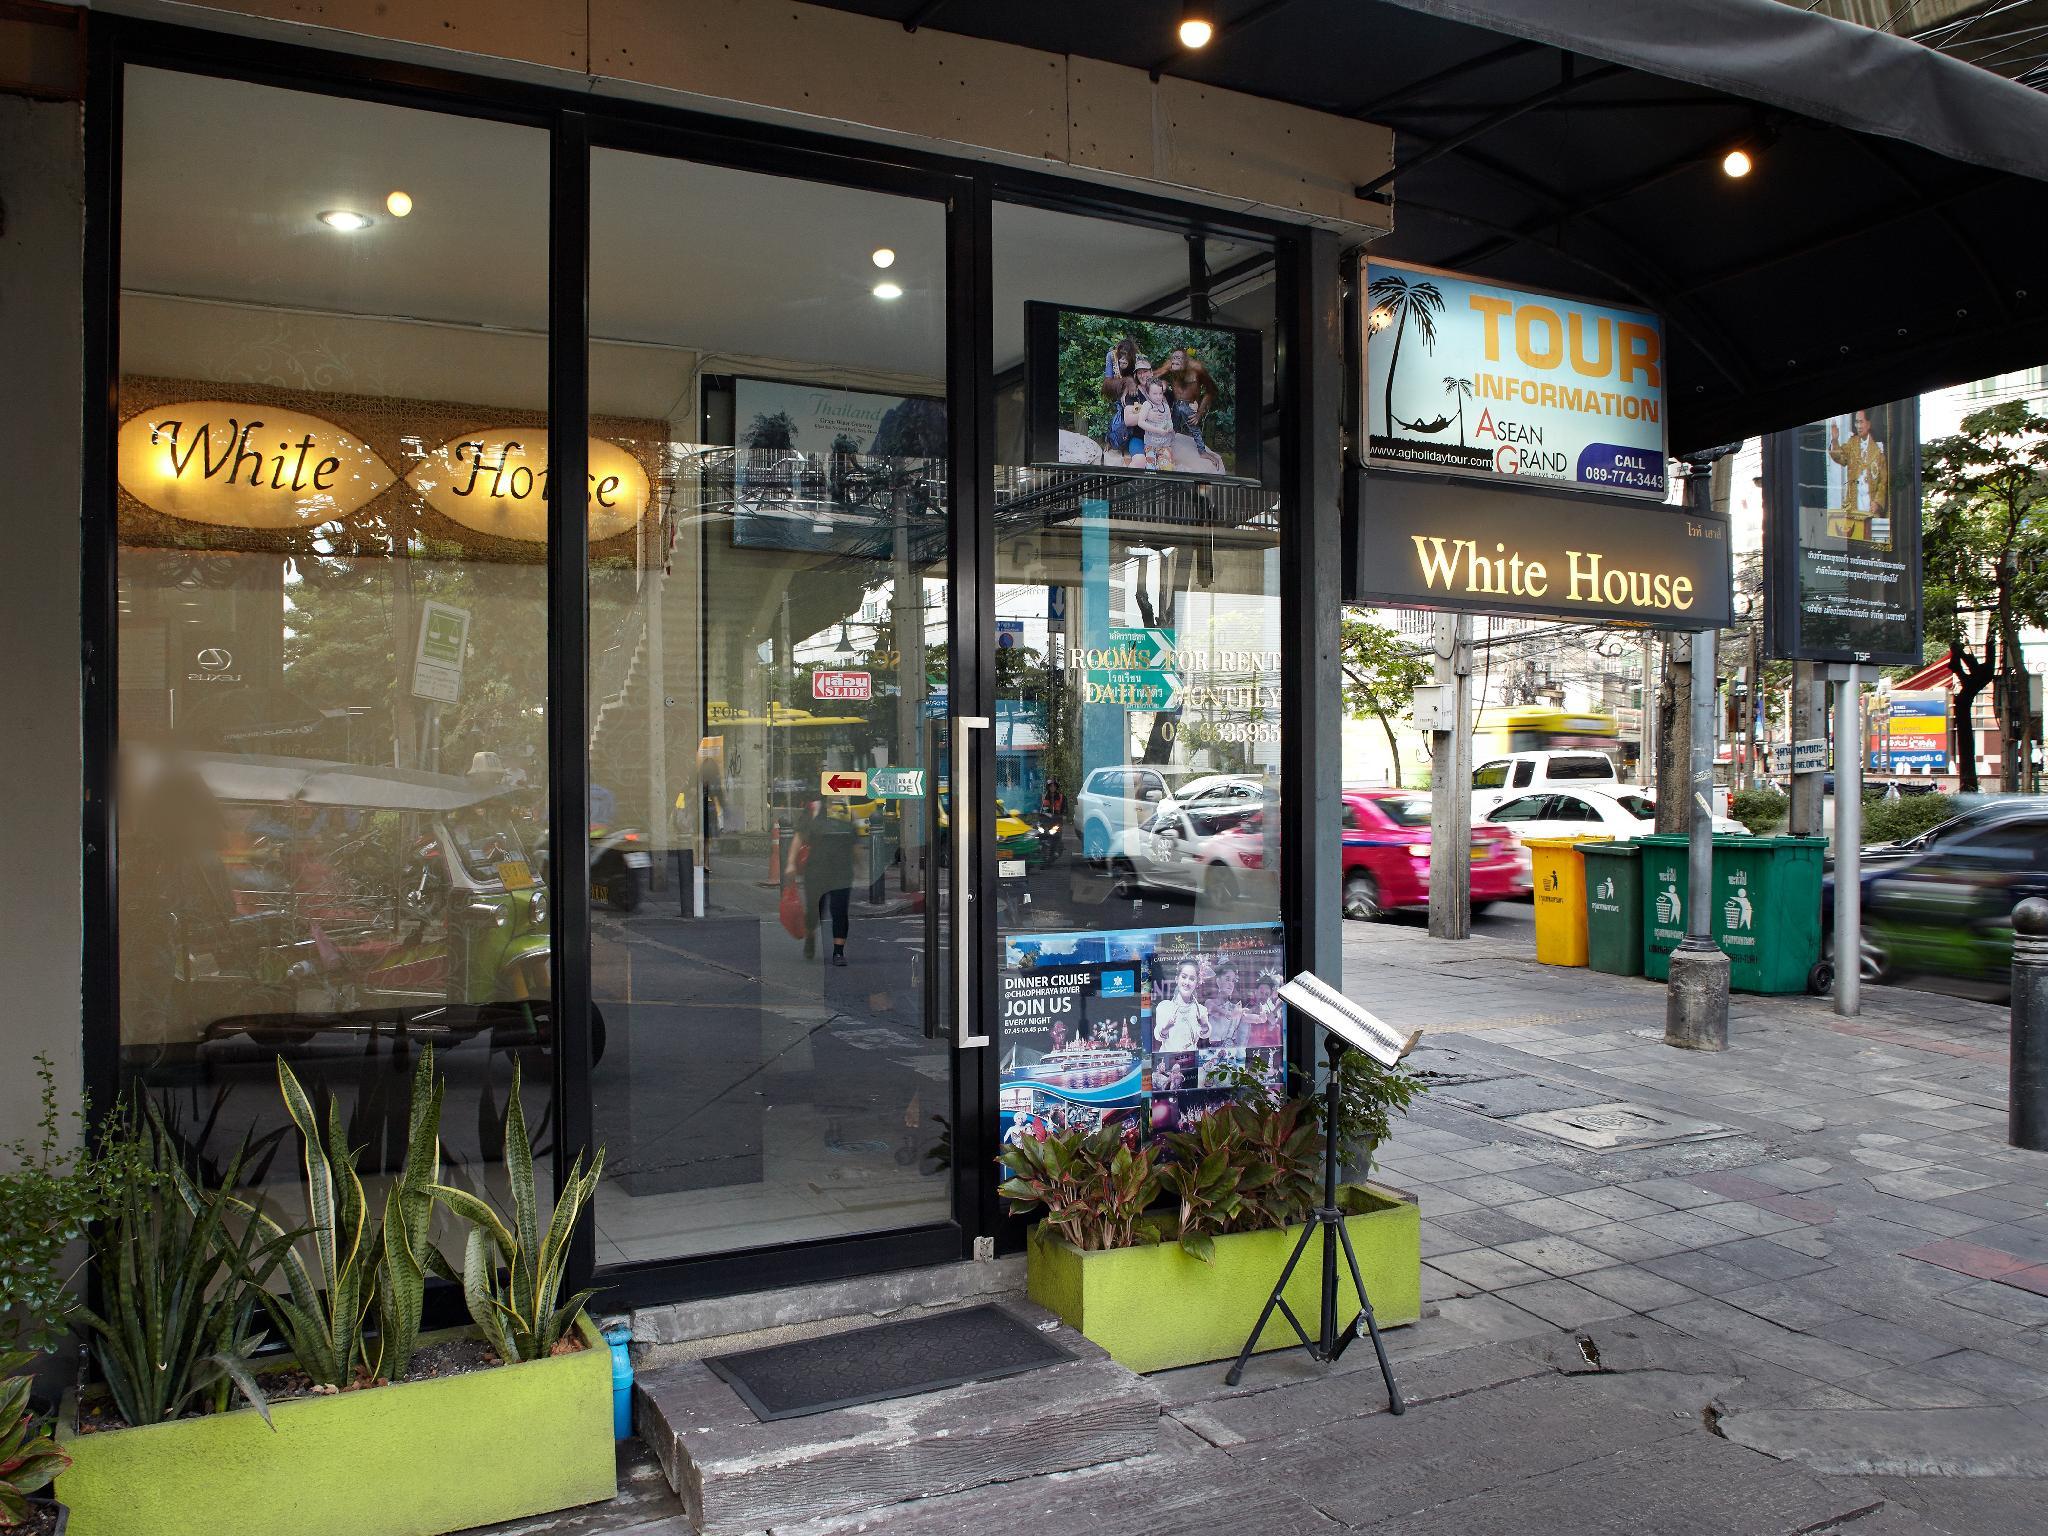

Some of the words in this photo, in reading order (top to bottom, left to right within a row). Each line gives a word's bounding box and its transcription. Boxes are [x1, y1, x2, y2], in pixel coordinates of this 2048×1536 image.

[1469, 294, 1661, 388] TOUR
[809, 393, 882, 421] Thailand
[1474, 373, 1659, 423] INFORMATION
[1475, 407, 1543, 446] ASEAN
[151, 418, 340, 491] White
[1370, 446, 1492, 467] www.agholidaytour.com
[1495, 444, 1568, 475] GRAND
[1614, 454, 1646, 471] CALL
[1585, 468, 1664, 489] 089-774-3443
[1411, 535, 1548, 598] White
[1565, 550, 1694, 611] House
[1068, 648, 1151, 670] ROOMS
[1163, 650, 1209, 671] FOR
[1218, 651, 1281, 672] RENT
[1854, 651, 1871, 661] TSF
[825, 687, 868, 697] SLIDE
[1084, 682, 1158, 705] DAILY
[879, 785, 913, 793] SLIDE
[1004, 987, 1059, 999] @CHAOPHRAYA
[1059, 985, 1080, 995] RIVER
[1005, 976, 1049, 990] DINNER
[1050, 973, 1091, 987] CRUISE
[1004, 999, 1046, 1017] JOIN
[1049, 997, 1072, 1013] US
[1004, 1019, 1027, 1027] EVERY
[1028, 1017, 1051, 1025] NIGHT
